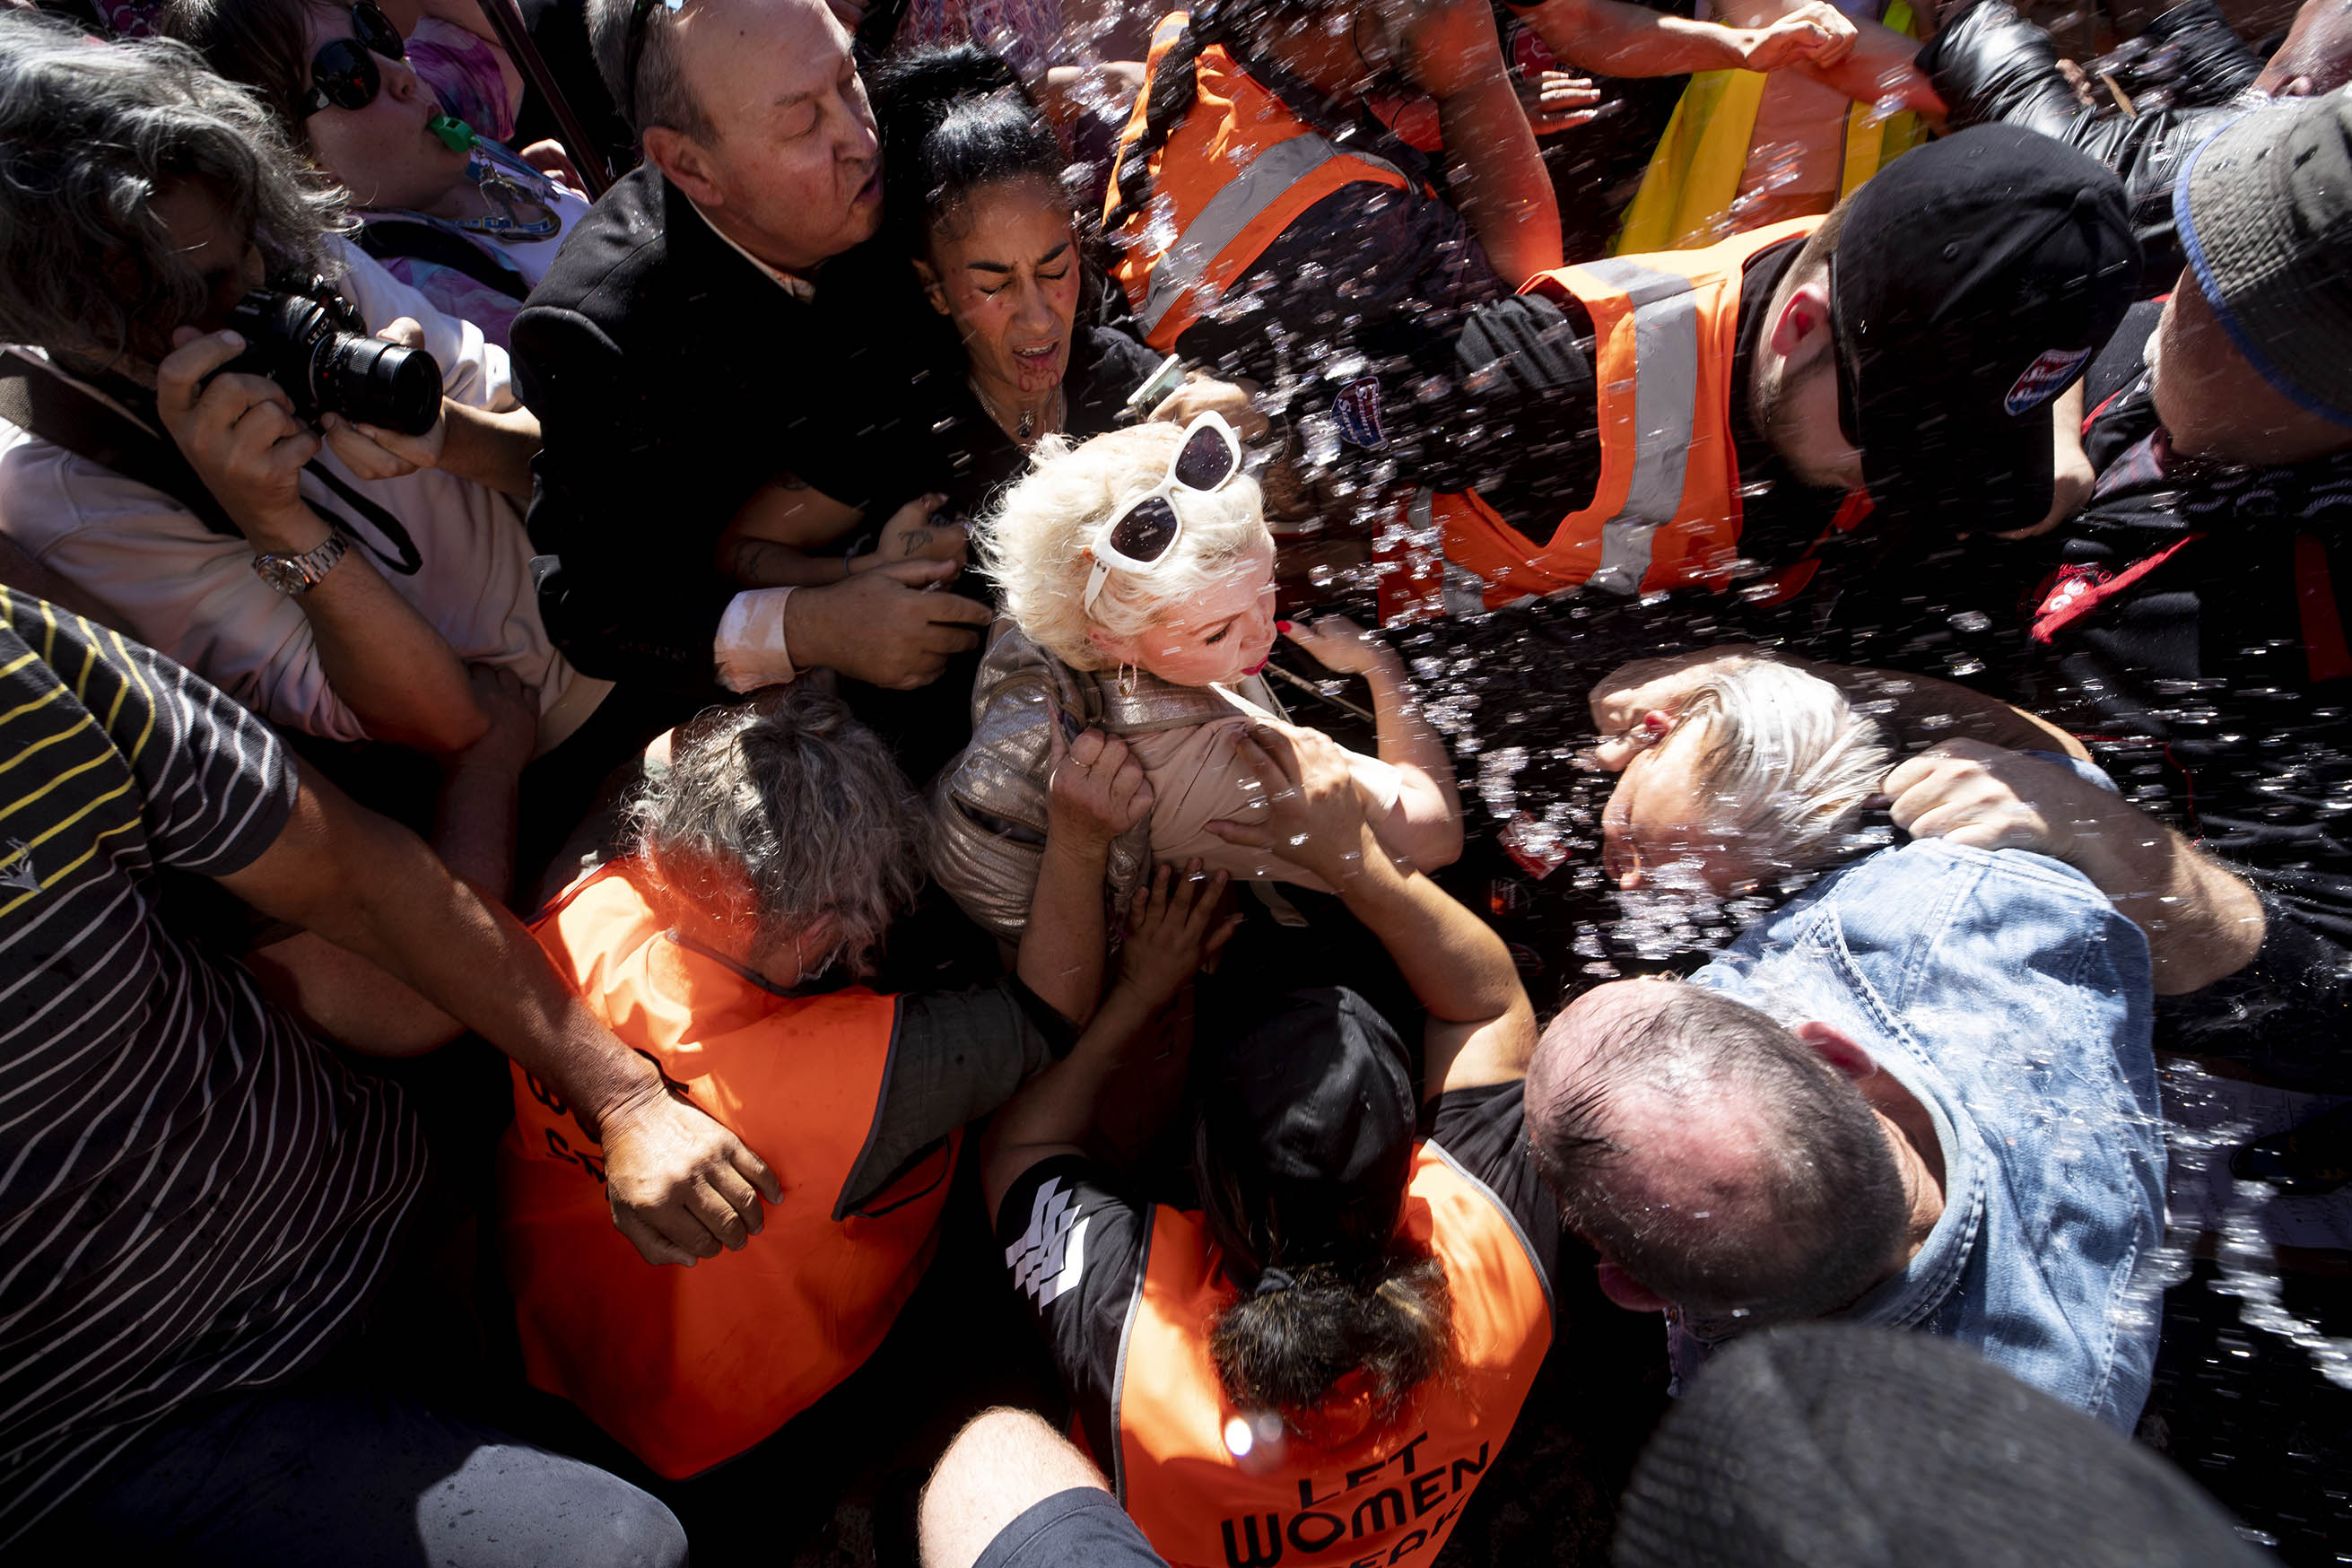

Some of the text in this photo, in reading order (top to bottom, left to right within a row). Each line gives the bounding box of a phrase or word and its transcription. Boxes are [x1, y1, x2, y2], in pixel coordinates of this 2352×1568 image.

[307, 317, 330, 345] LEICA
[1221, 1441, 1489, 1568] WOMEN
[1299, 1431, 1427, 1510] LET
